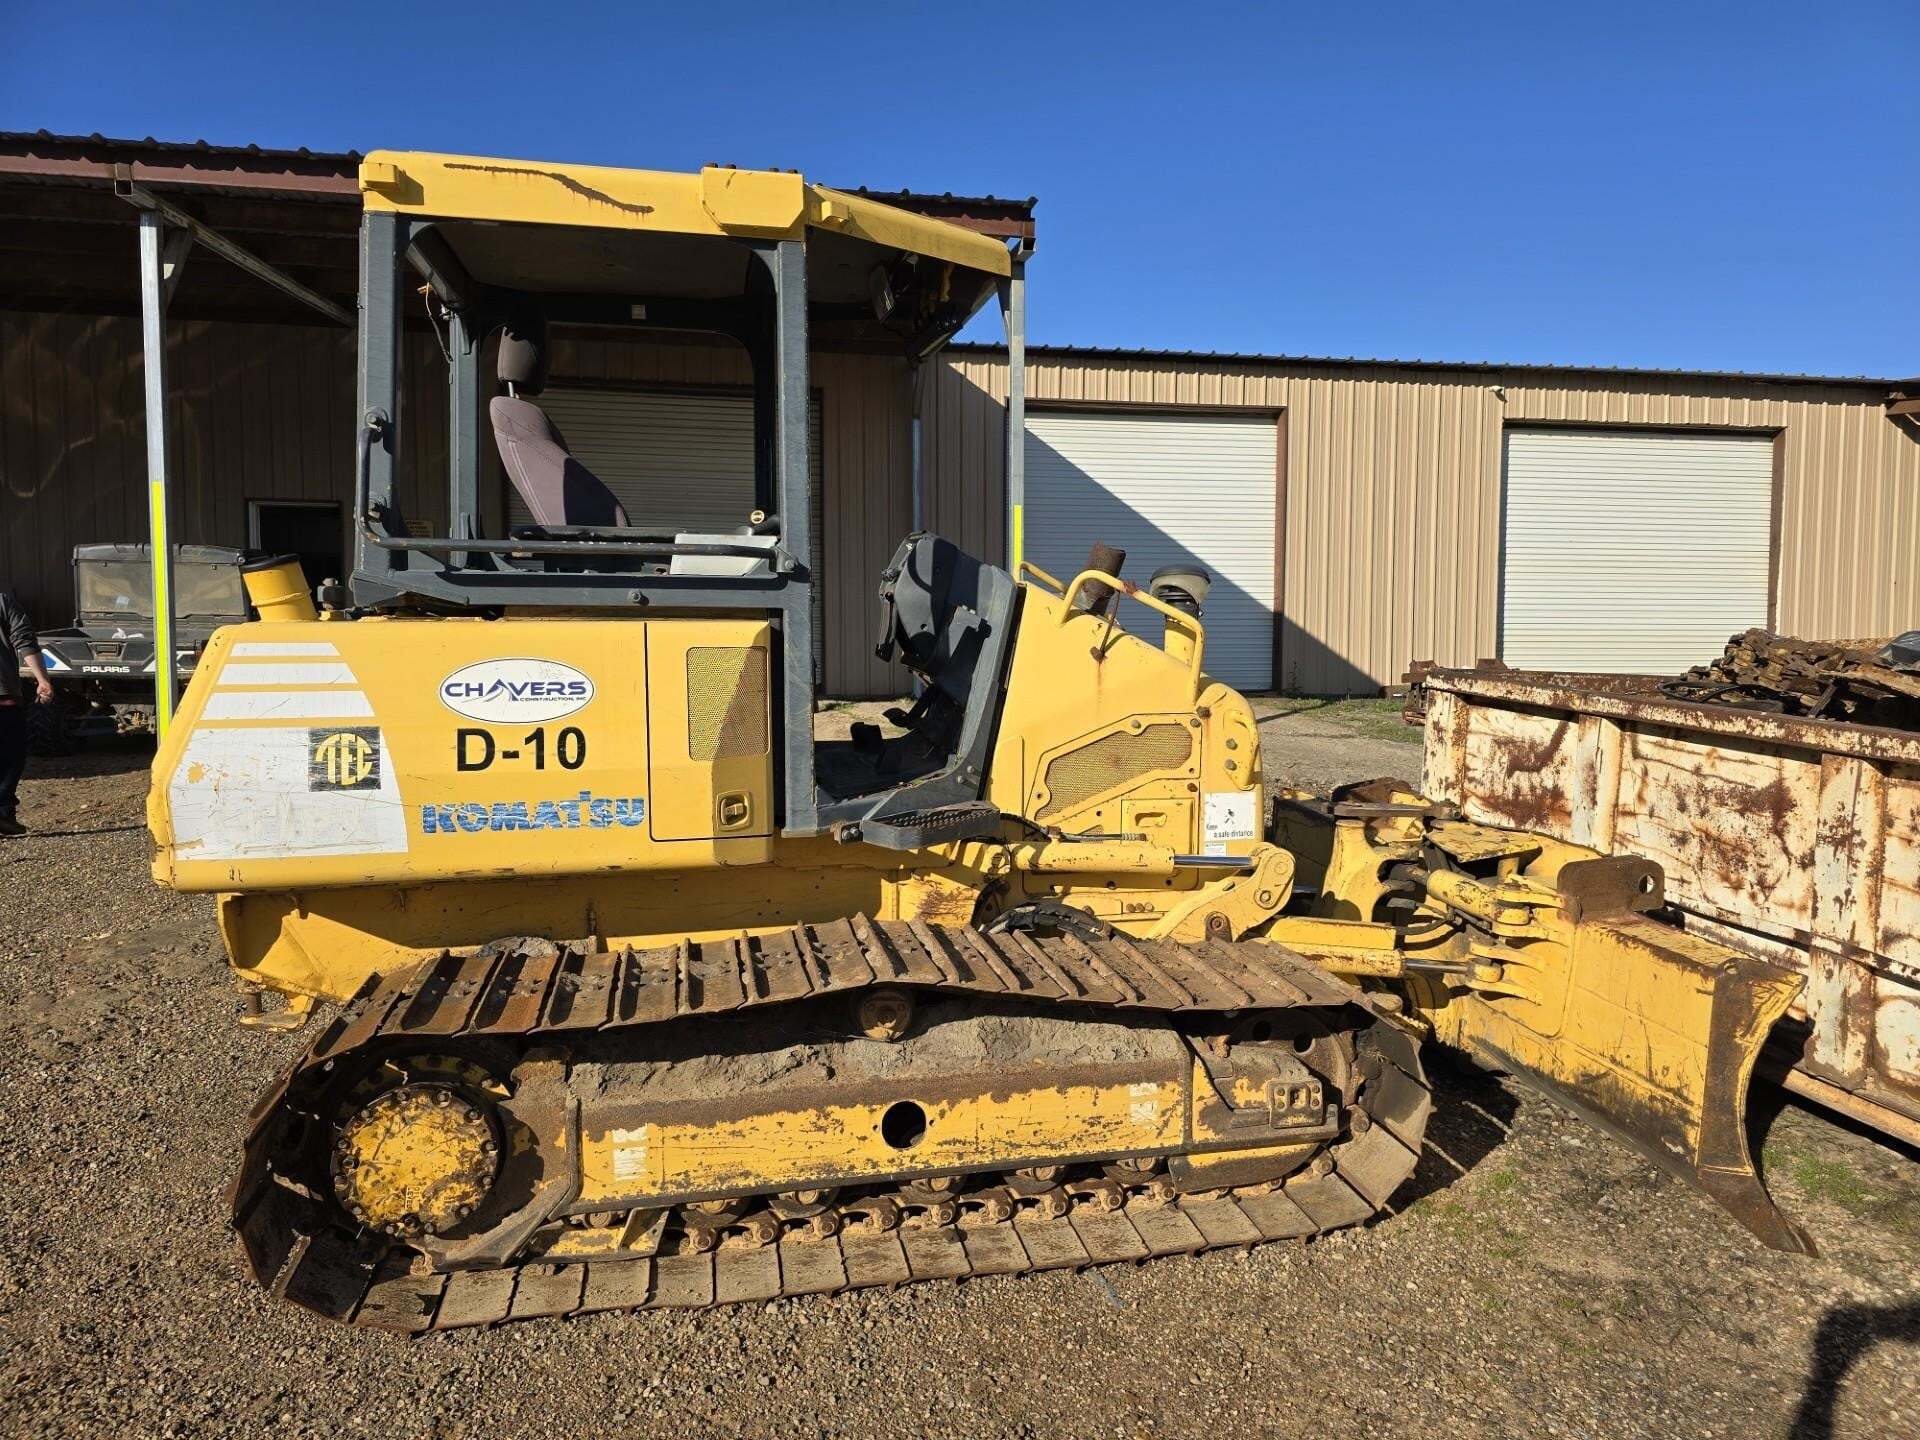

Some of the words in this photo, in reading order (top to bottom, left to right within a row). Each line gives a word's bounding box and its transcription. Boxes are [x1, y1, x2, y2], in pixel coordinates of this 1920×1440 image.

[444, 679, 587, 701] CHAVERS
[457, 726, 587, 771] D-10
[422, 790, 645, 833] KOMATSU
[1219, 830, 1230, 838] safe
